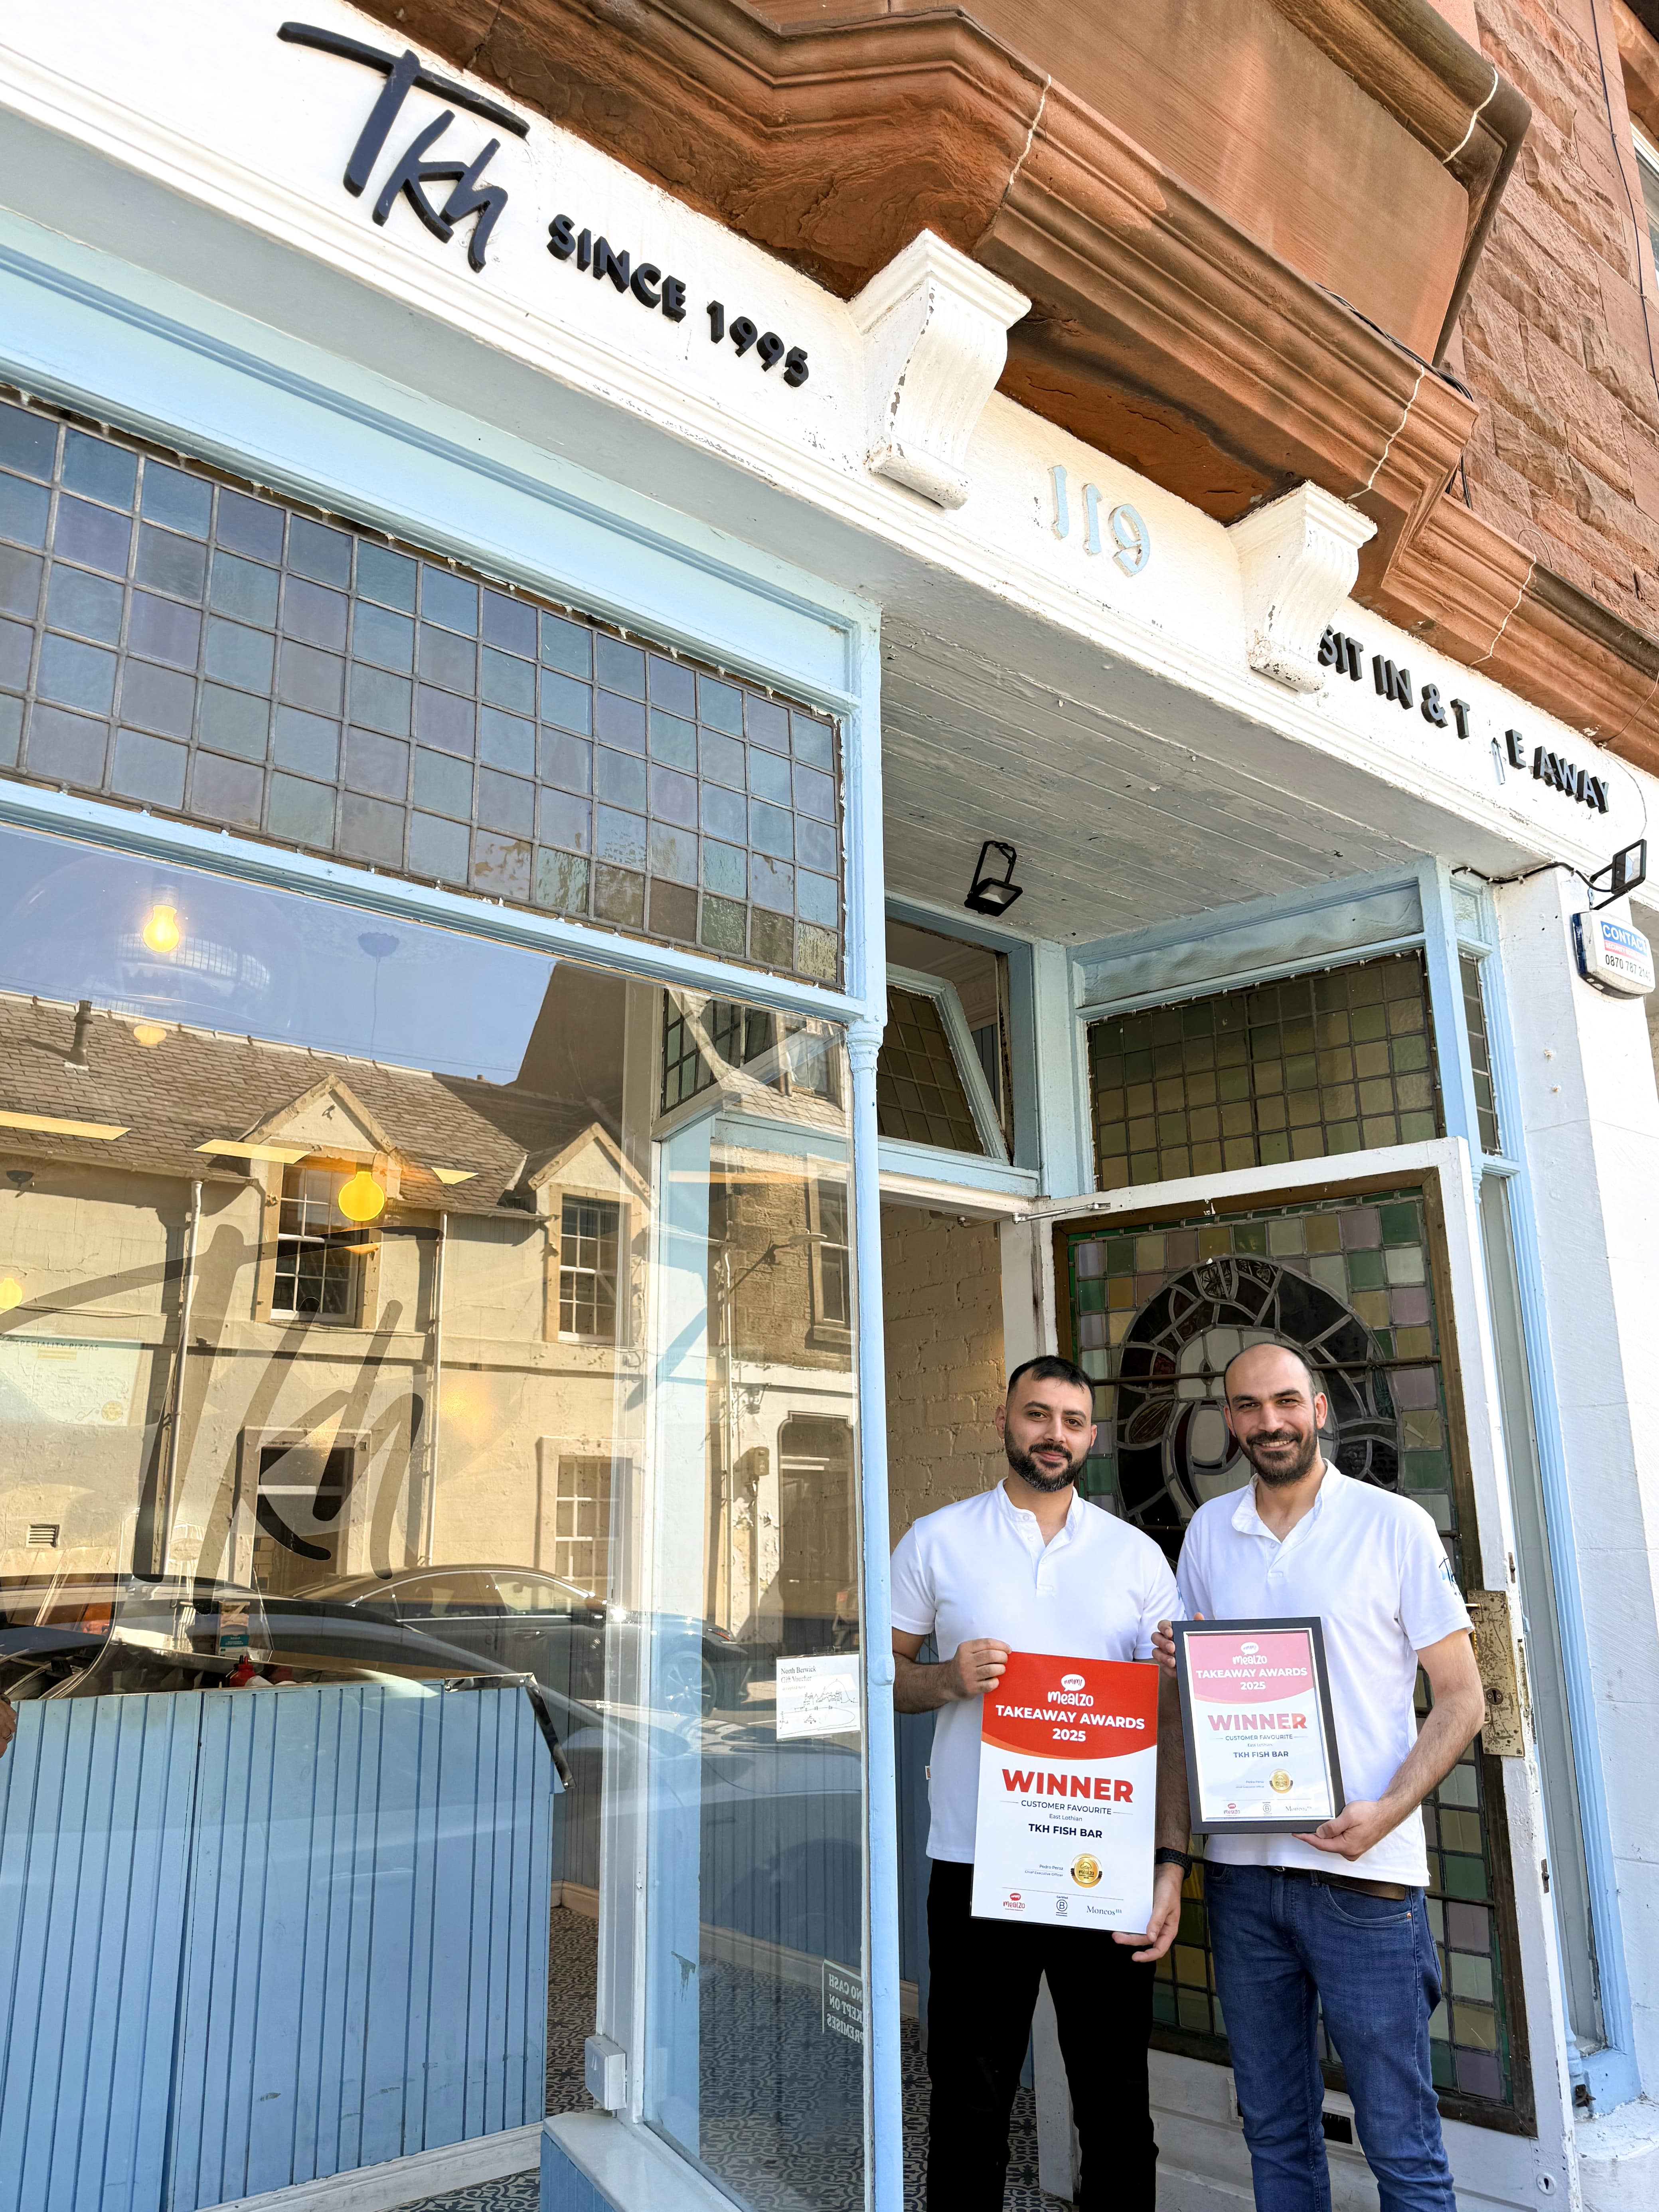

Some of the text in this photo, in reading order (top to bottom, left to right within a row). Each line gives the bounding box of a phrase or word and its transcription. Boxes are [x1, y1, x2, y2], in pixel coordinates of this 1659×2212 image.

[546, 213, 809, 387] SINCE 1995
[1047, 464, 1150, 577] 119
[1317, 624, 1364, 682] SIT
[1372, 654, 1414, 710] IN
[1420, 683, 1449, 729] &
[1533, 745, 1610, 814] AWAY
[1602, 924, 1647, 953] CONTACT
[1606, 954, 1623, 969] 0870
[1625, 960, 1637, 974] 787
[15, 1339, 65, 1349] SPECIALITY
[1196, 1667, 1307, 1679] TAKEAWAY AWARDS
[1240, 1681, 1266, 1690] 2025
[1048, 1691, 1094, 1706] mealzo
[996, 1704, 1145, 1730] TAKEAWAY AWARDS
[1207, 1713, 1308, 1731] WINNER
[1053, 1728, 1086, 1742] 2025
[1002, 1769, 1134, 1803] WINNER
[1021, 1800, 1112, 1815] CUSTOMER FAVOURITE
[1028, 1823, 1102, 1839] TKH FISH BAR
